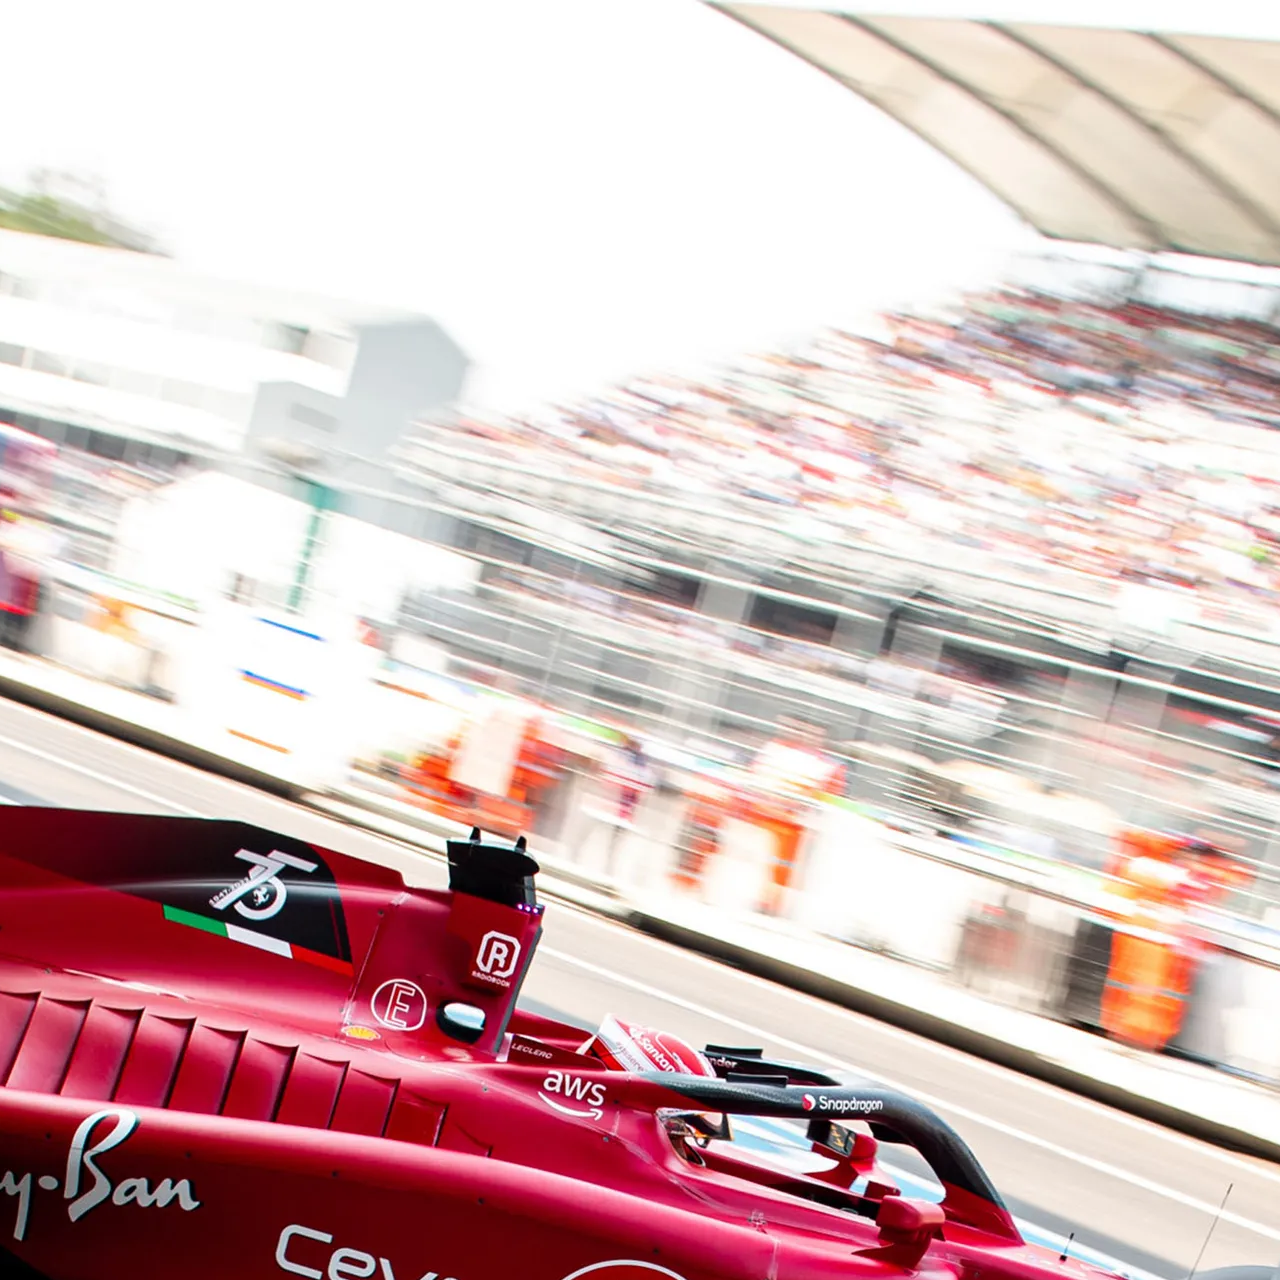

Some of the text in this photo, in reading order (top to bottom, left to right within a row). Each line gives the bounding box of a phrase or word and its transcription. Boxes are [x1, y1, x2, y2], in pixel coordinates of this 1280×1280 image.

[511, 1042, 553, 1060] LECLERC
[543, 1069, 607, 1107] aws
[819, 1095, 883, 1114] Snapdragon
